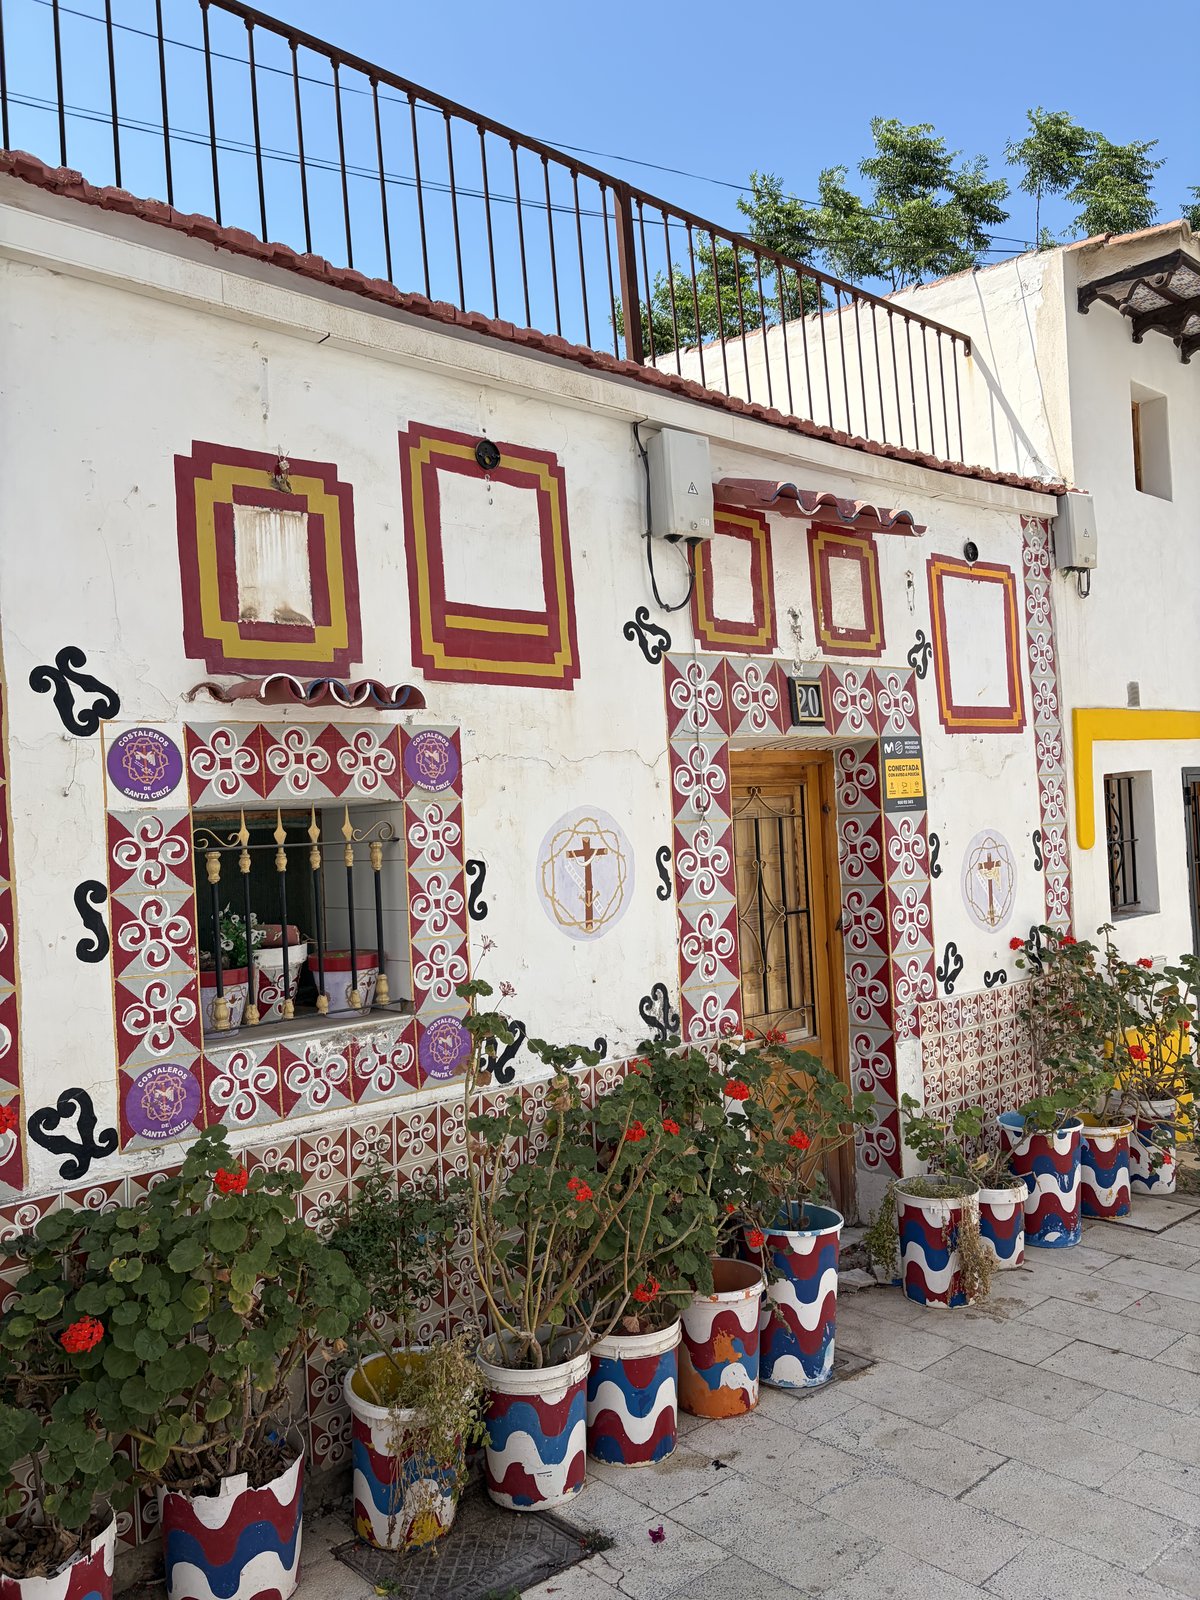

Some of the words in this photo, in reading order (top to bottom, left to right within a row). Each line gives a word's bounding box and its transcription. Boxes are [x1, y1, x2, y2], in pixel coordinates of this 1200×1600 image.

[797, 686, 819, 717] 20
[118, 730, 169, 747] COSTALEROS
[412, 732, 450, 747] COSTALEROS
[123, 787, 150, 800] SANTA
[150, 785, 171, 799] CRUZ
[416, 780, 435, 790] SANTA
[435, 779, 451, 791] CRUZ
[426, 1017, 463, 1035] COSTALEROS
[137, 1066, 188, 1088] COSTALEROS
[430, 1069, 448, 1078] SANTA
[141, 1128, 167, 1138] SANTA
[168, 1119, 189, 1135] CRUZ
